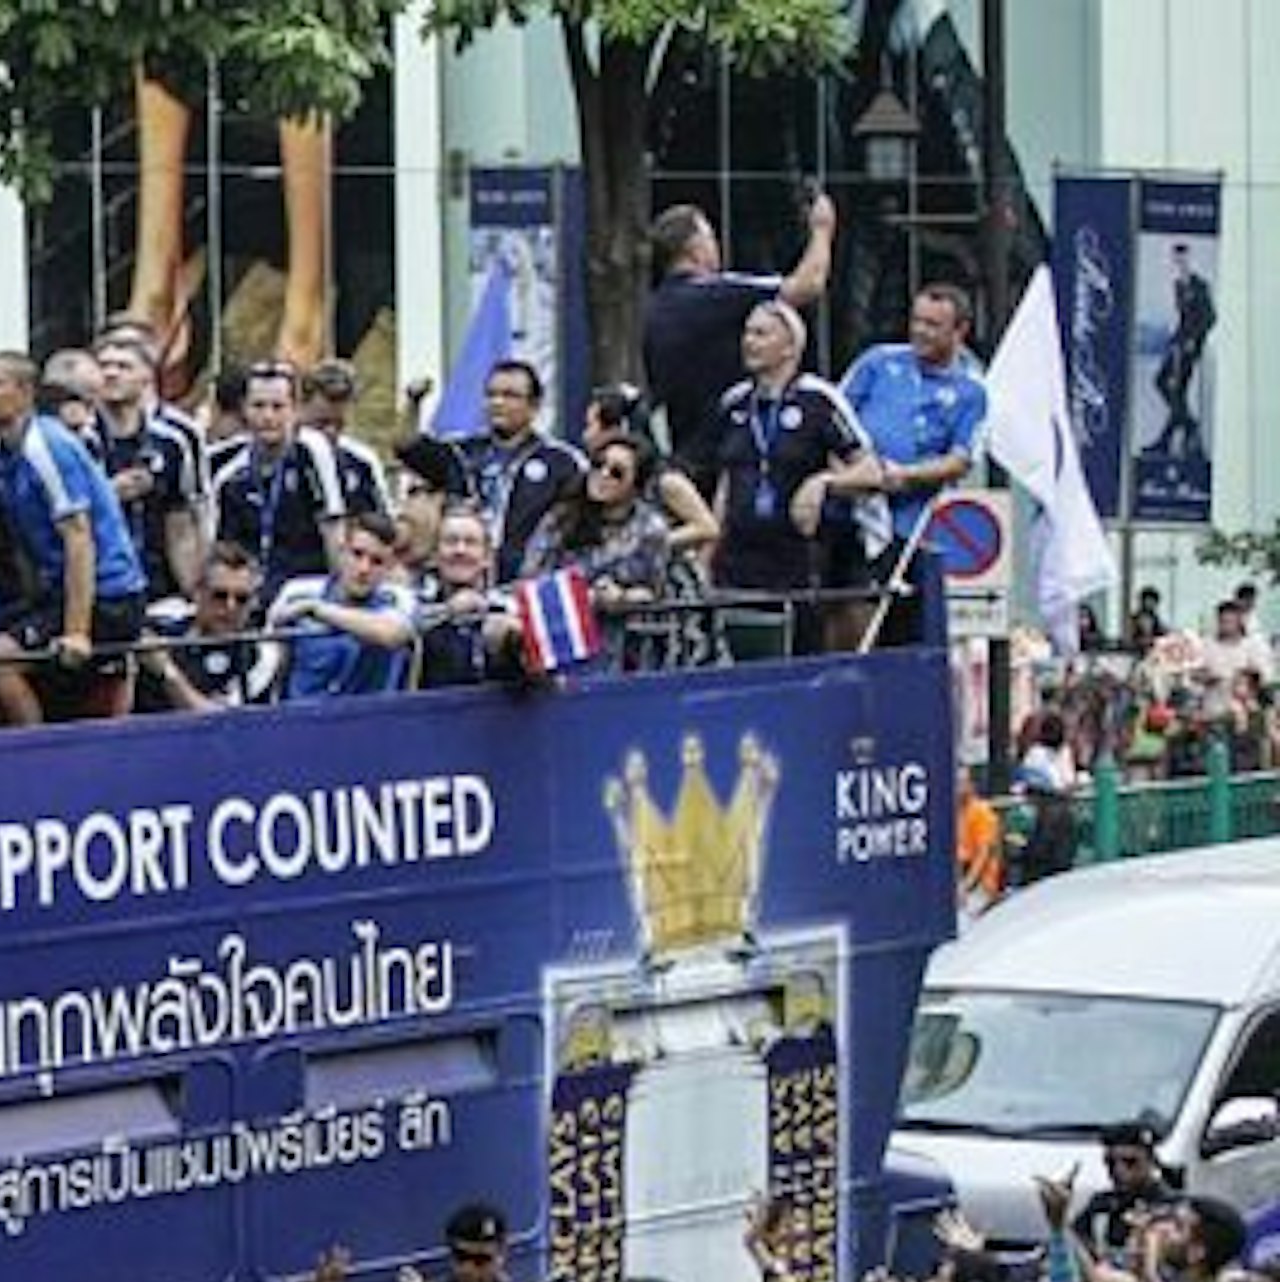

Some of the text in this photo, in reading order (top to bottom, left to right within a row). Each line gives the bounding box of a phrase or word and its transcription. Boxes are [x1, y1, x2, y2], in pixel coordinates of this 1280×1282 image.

[837, 763, 927, 818] KING
[206, 775, 495, 884] COUNTED
[837, 817, 928, 864] POWER
